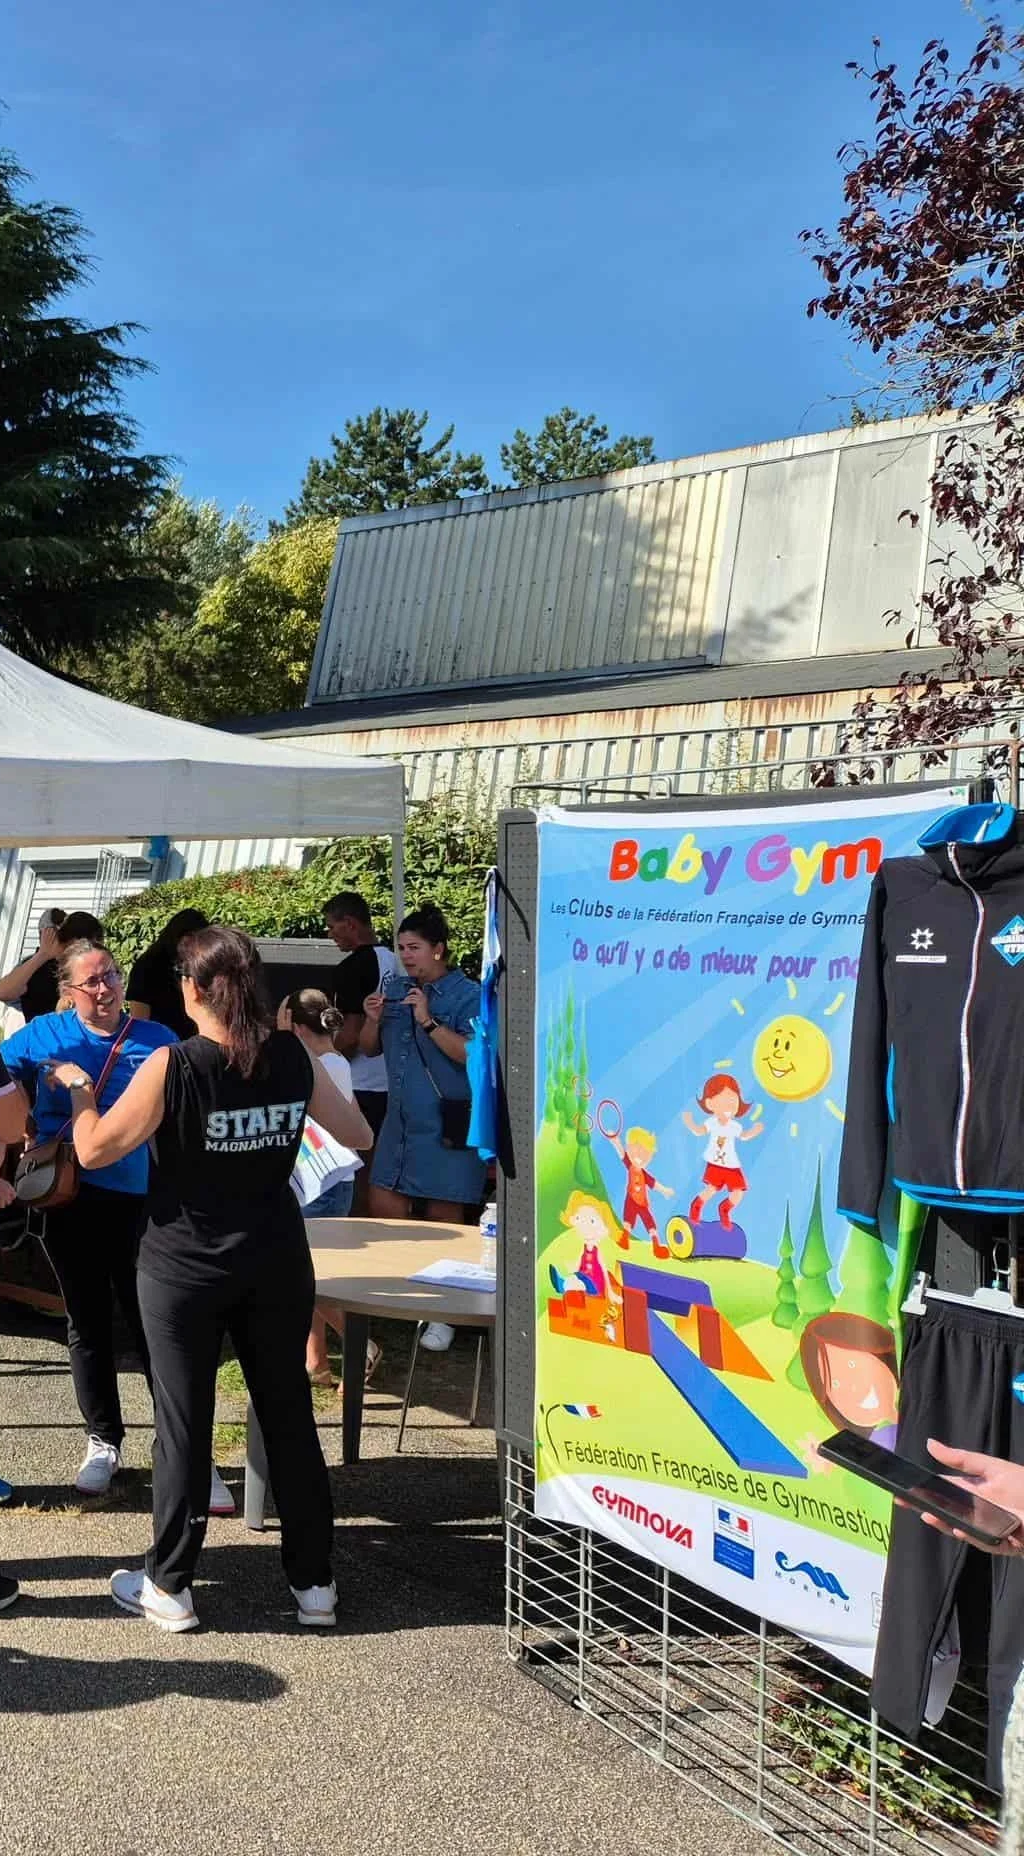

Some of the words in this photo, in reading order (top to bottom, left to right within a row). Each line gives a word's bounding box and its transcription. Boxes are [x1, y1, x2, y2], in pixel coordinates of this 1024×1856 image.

[609, 833, 732, 895] Baby
[745, 834, 882, 896] Gym
[551, 901, 566, 914] Les
[568, 898, 614, 919] Clubs
[617, 907, 631, 919] de
[633, 908, 644, 920] la
[647, 908, 713, 923] Fédération
[716, 910, 785, 927] Française
[789, 911, 807, 925] de
[572, 937, 588, 961] Ce
[596, 940, 629, 968] qu'il
[635, 947, 646, 974] y
[653, 948, 665, 969] a
[668, 944, 691, 971] de
[701, 946, 758, 975] mieux
[767, 954, 817, 983] pour
[207, 1100, 306, 1139] STAFF
[564, 1440, 648, 1473] Fédération
[652, 1452, 739, 1493] Française
[744, 1473, 768, 1502] de
[775, 1571, 851, 1612] MOREAU
